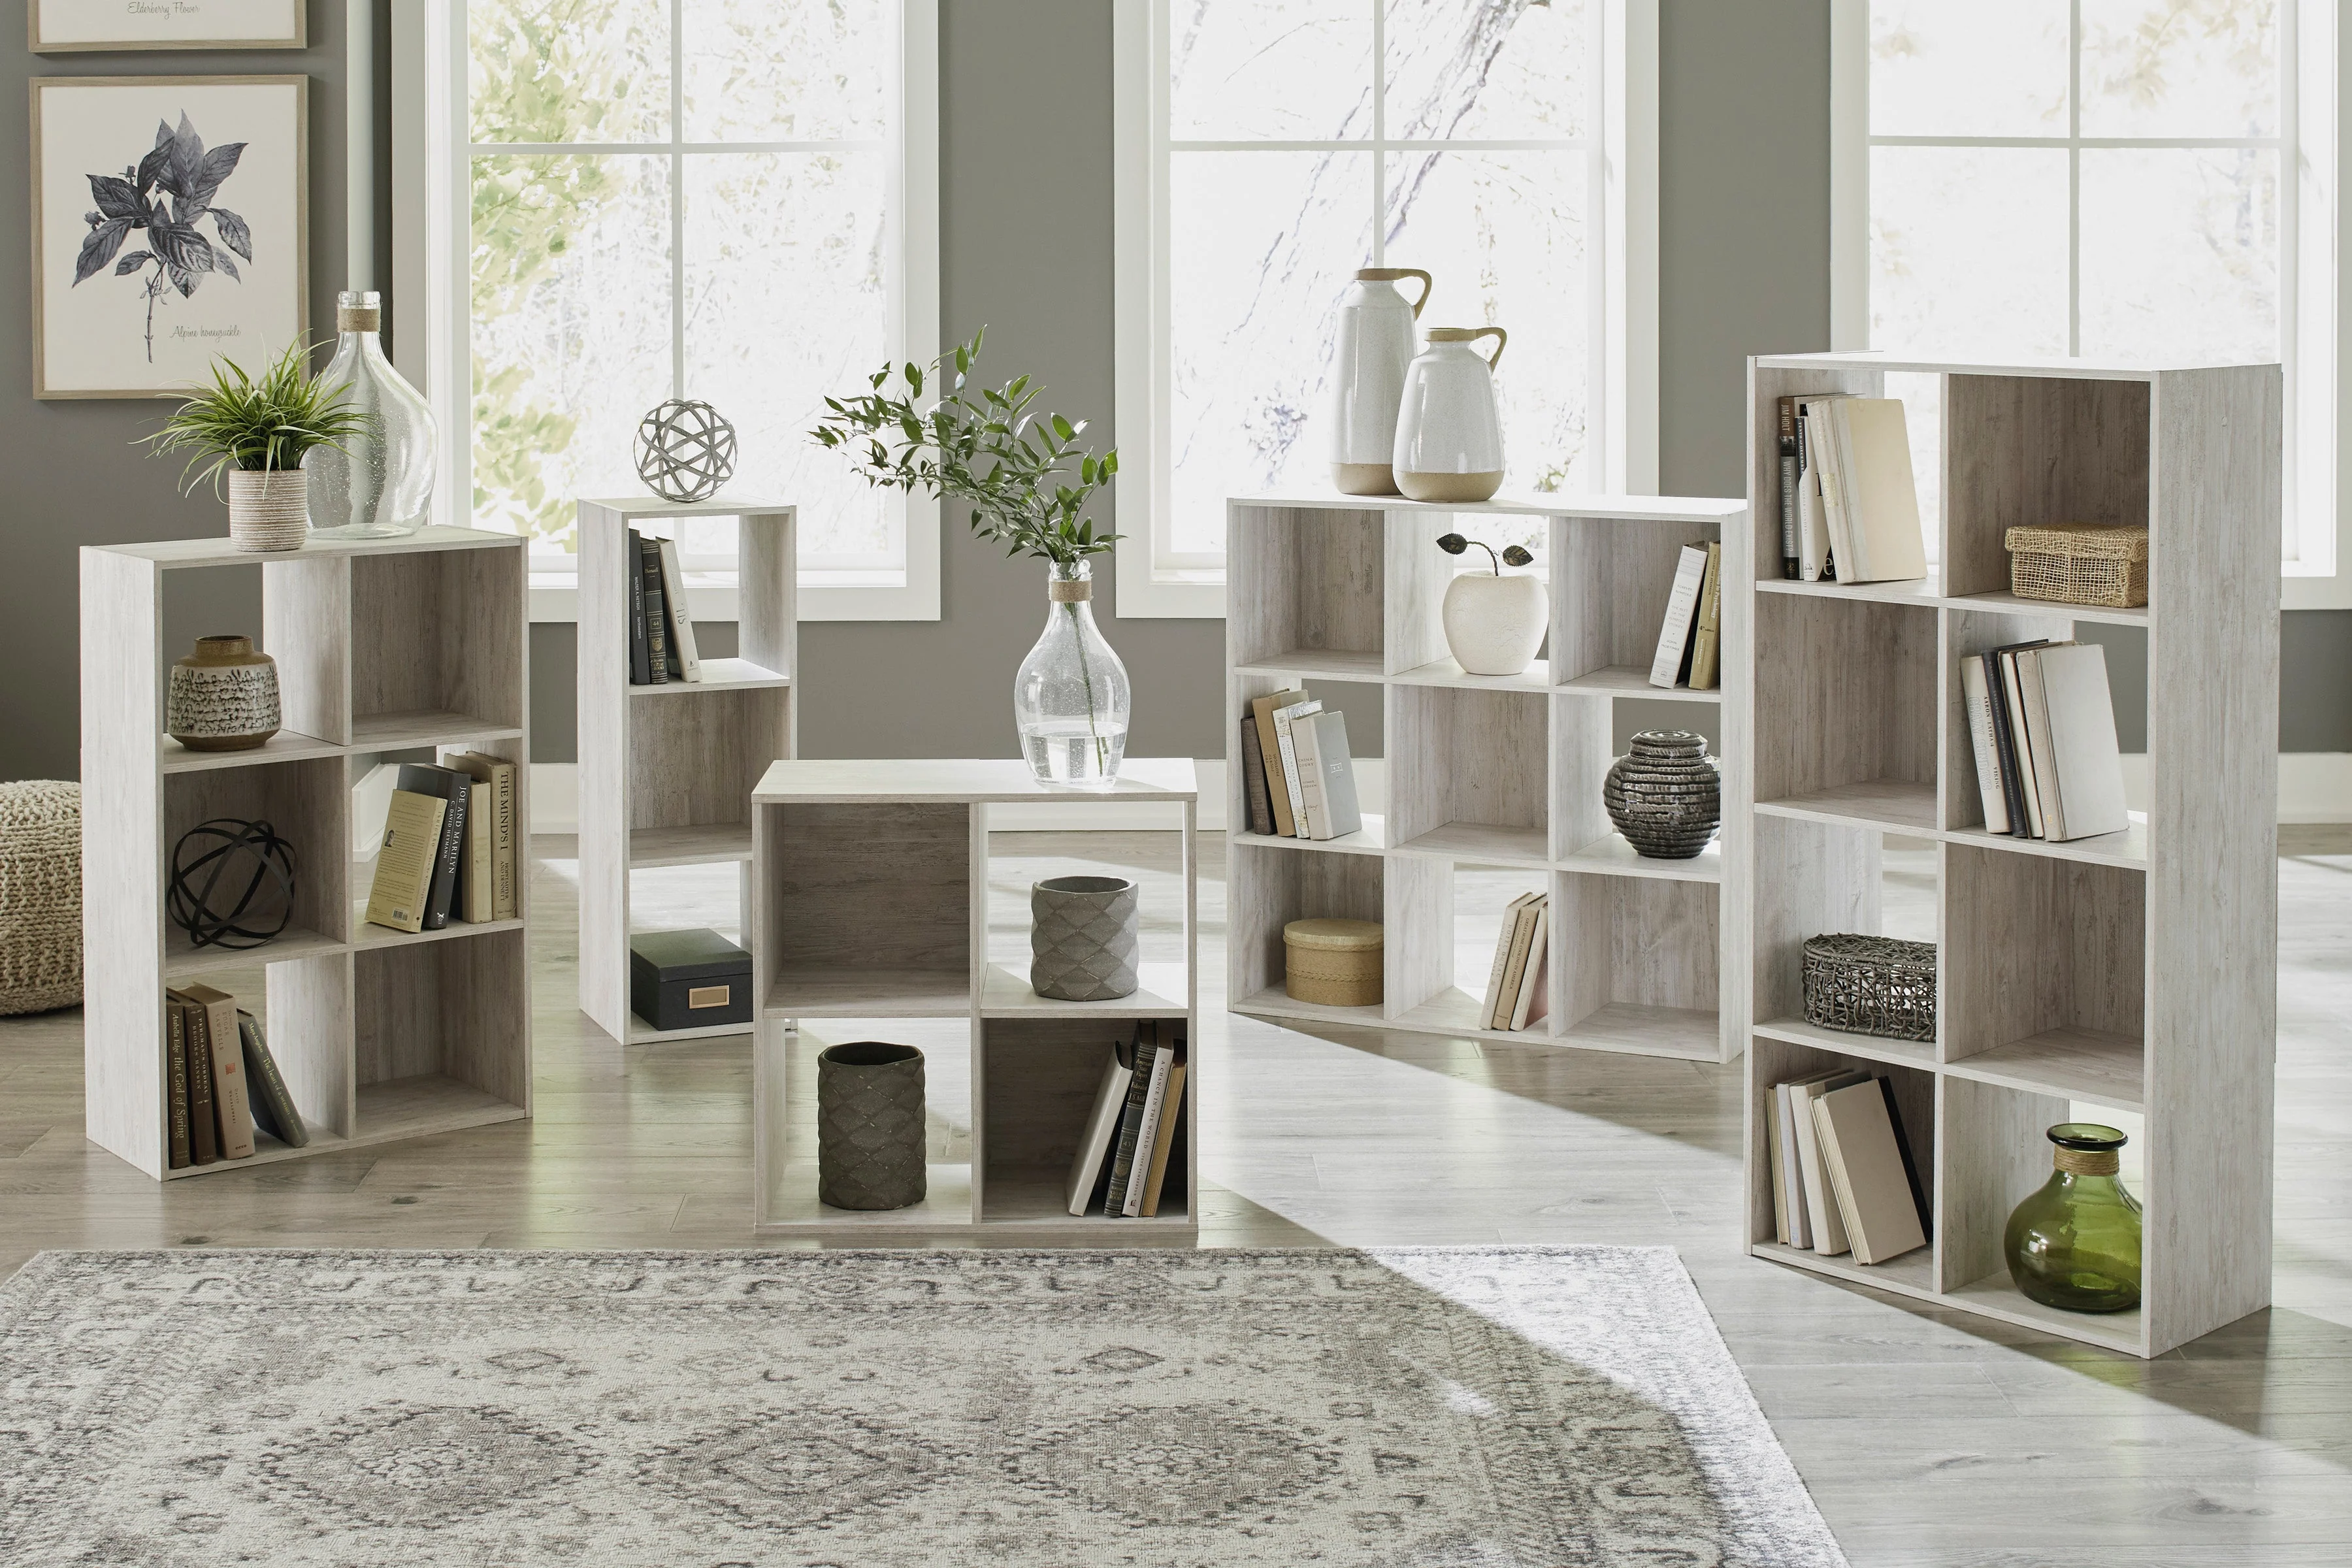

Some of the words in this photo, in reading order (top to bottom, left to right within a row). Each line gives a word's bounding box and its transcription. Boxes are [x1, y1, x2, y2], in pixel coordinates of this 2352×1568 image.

[127, 2, 171, 20] Elderberry
[172, 2, 201, 13] Flower
[169, 325, 198, 342] Alpine
[200, 325, 241, 342] honeysuckle
[1780, 404, 1789, 414] JIM
[1781, 416, 1789, 431] HOLT
[1782, 461, 1791, 475] WHY
[1783, 477, 1791, 493] DOES
[1785, 530, 1793, 551] EXIST?
[1710, 592, 1720, 619] Psychology
[1967, 696, 1985, 735] CRAZY
[1986, 722, 1995, 747] LATHAM
[1973, 738, 1994, 791] SUNDAYS
[500, 771, 508, 797] THE
[1992, 766, 2001, 789] VIKING
[457, 785, 467, 803] JOE
[454, 806, 464, 827] AND
[500, 799, 509, 842] MIND'S
[442, 829, 451, 858] HEYMANN
[447, 831, 460, 874] MARILYN
[1502, 924, 1512, 948] HOTEL
[1514, 945, 1523, 964] COOKING
[1509, 970, 1517, 989] AMERICA
[214, 1013, 224, 1051] SAWTELLE
[246, 1022, 257, 1036] Maya
[172, 1039, 180, 1053] Edge
[174, 1056, 184, 1070] the
[261, 1054, 273, 1070] The
[267, 1068, 280, 1084] heart
[274, 1083, 283, 1092] of
[174, 1073, 185, 1093] God
[1154, 1067, 1164, 1095] CHANCE
[172, 1096, 186, 1107] of
[1152, 1097, 1158, 1105] IN
[173, 1108, 187, 1139] Spring
[1143, 1124, 1152, 1149] WORLD
